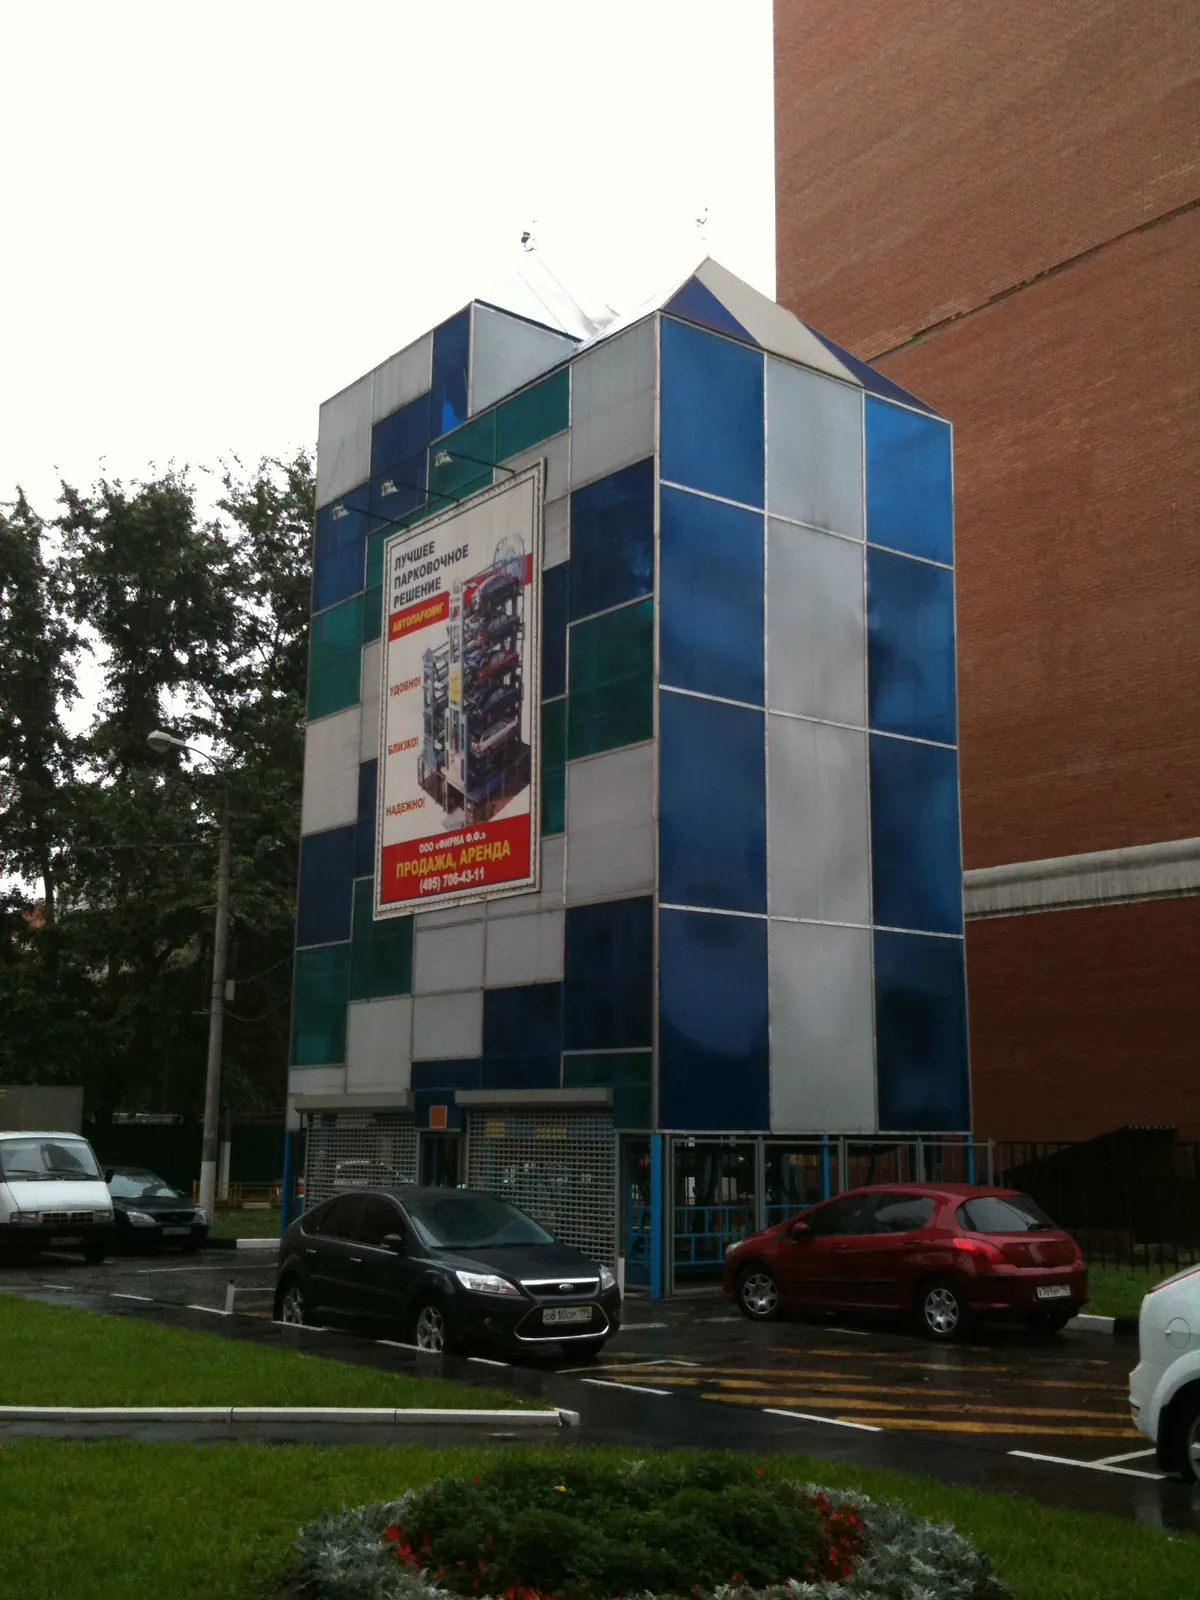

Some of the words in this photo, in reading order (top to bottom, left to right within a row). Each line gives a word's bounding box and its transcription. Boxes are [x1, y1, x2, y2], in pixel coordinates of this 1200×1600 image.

[394, 541, 435, 571] ЛУЧШЕЕ
[394, 544, 469, 590] ПАРКОВОЧНОЕ
[393, 577, 441, 609] РЕШЕНИЕ
[388, 736, 419, 755] БЛИЗКО!
[386, 797, 425, 817] НАДЕЖНО!
[396, 853, 457, 879] ПРОДАЖА,
[459, 840, 511, 865] АРЕНДА
[419, 876, 441, 894] (495)
[443, 867, 485, 887] 706-43-11
